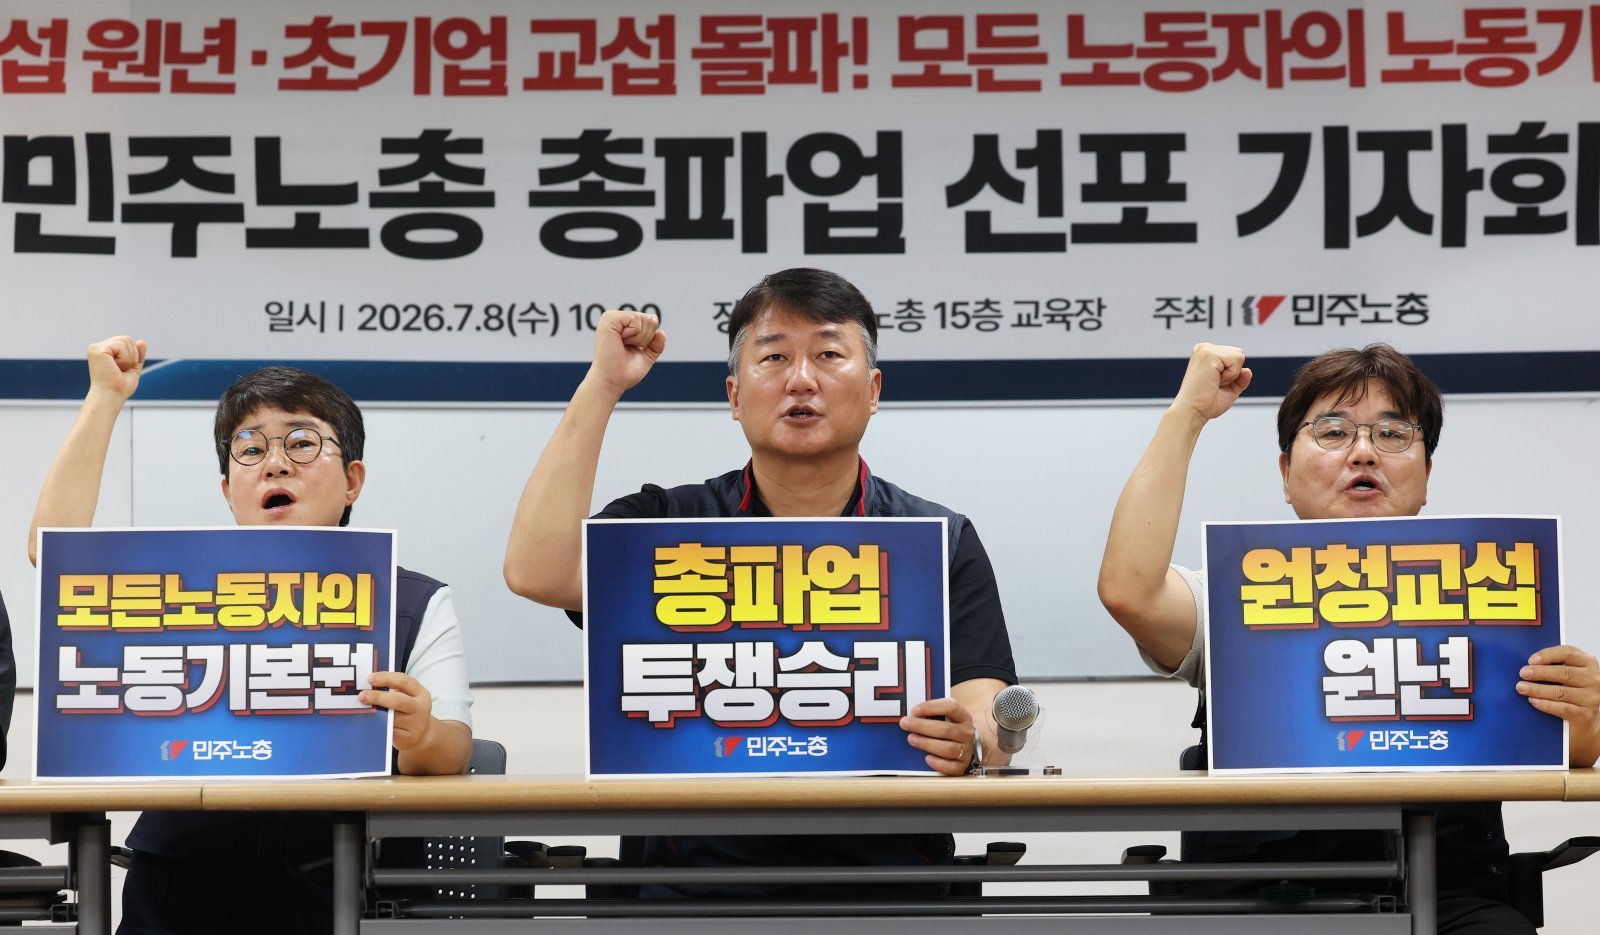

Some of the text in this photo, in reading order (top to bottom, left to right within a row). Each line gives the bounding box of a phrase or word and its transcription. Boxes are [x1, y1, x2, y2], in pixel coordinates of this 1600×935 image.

[523, 15, 677, 96] 교섭
[692, 14, 868, 96] 돌파!
[892, 13, 1048, 93] 모든
[1060, 9, 1366, 92] 노동자의
[1381, 5, 1600, 88] 노동기
[2, 121, 1600, 260] 민주노총 총파업 선포 기자회
[264, 300, 326, 333] 일시
[357, 301, 560, 337] 2026.7.8(수)
[934, 299, 1004, 332] 15층
[1010, 298, 1107, 332] 교육장
[1153, 293, 1430, 330] 주최 민주노총
[57, 572, 374, 630] 모든노동자의
[653, 543, 890, 631] 총파업
[1240, 542, 1541, 629] 원청교섭
[56, 643, 375, 714] 노동기본권
[621, 640, 929, 726] 투쟁승리
[1322, 636, 1473, 720] 원년
[192, 739, 273, 761] 민주노총
[747, 735, 828, 757] 민주노총
[1369, 729, 1449, 751] 민주노총
